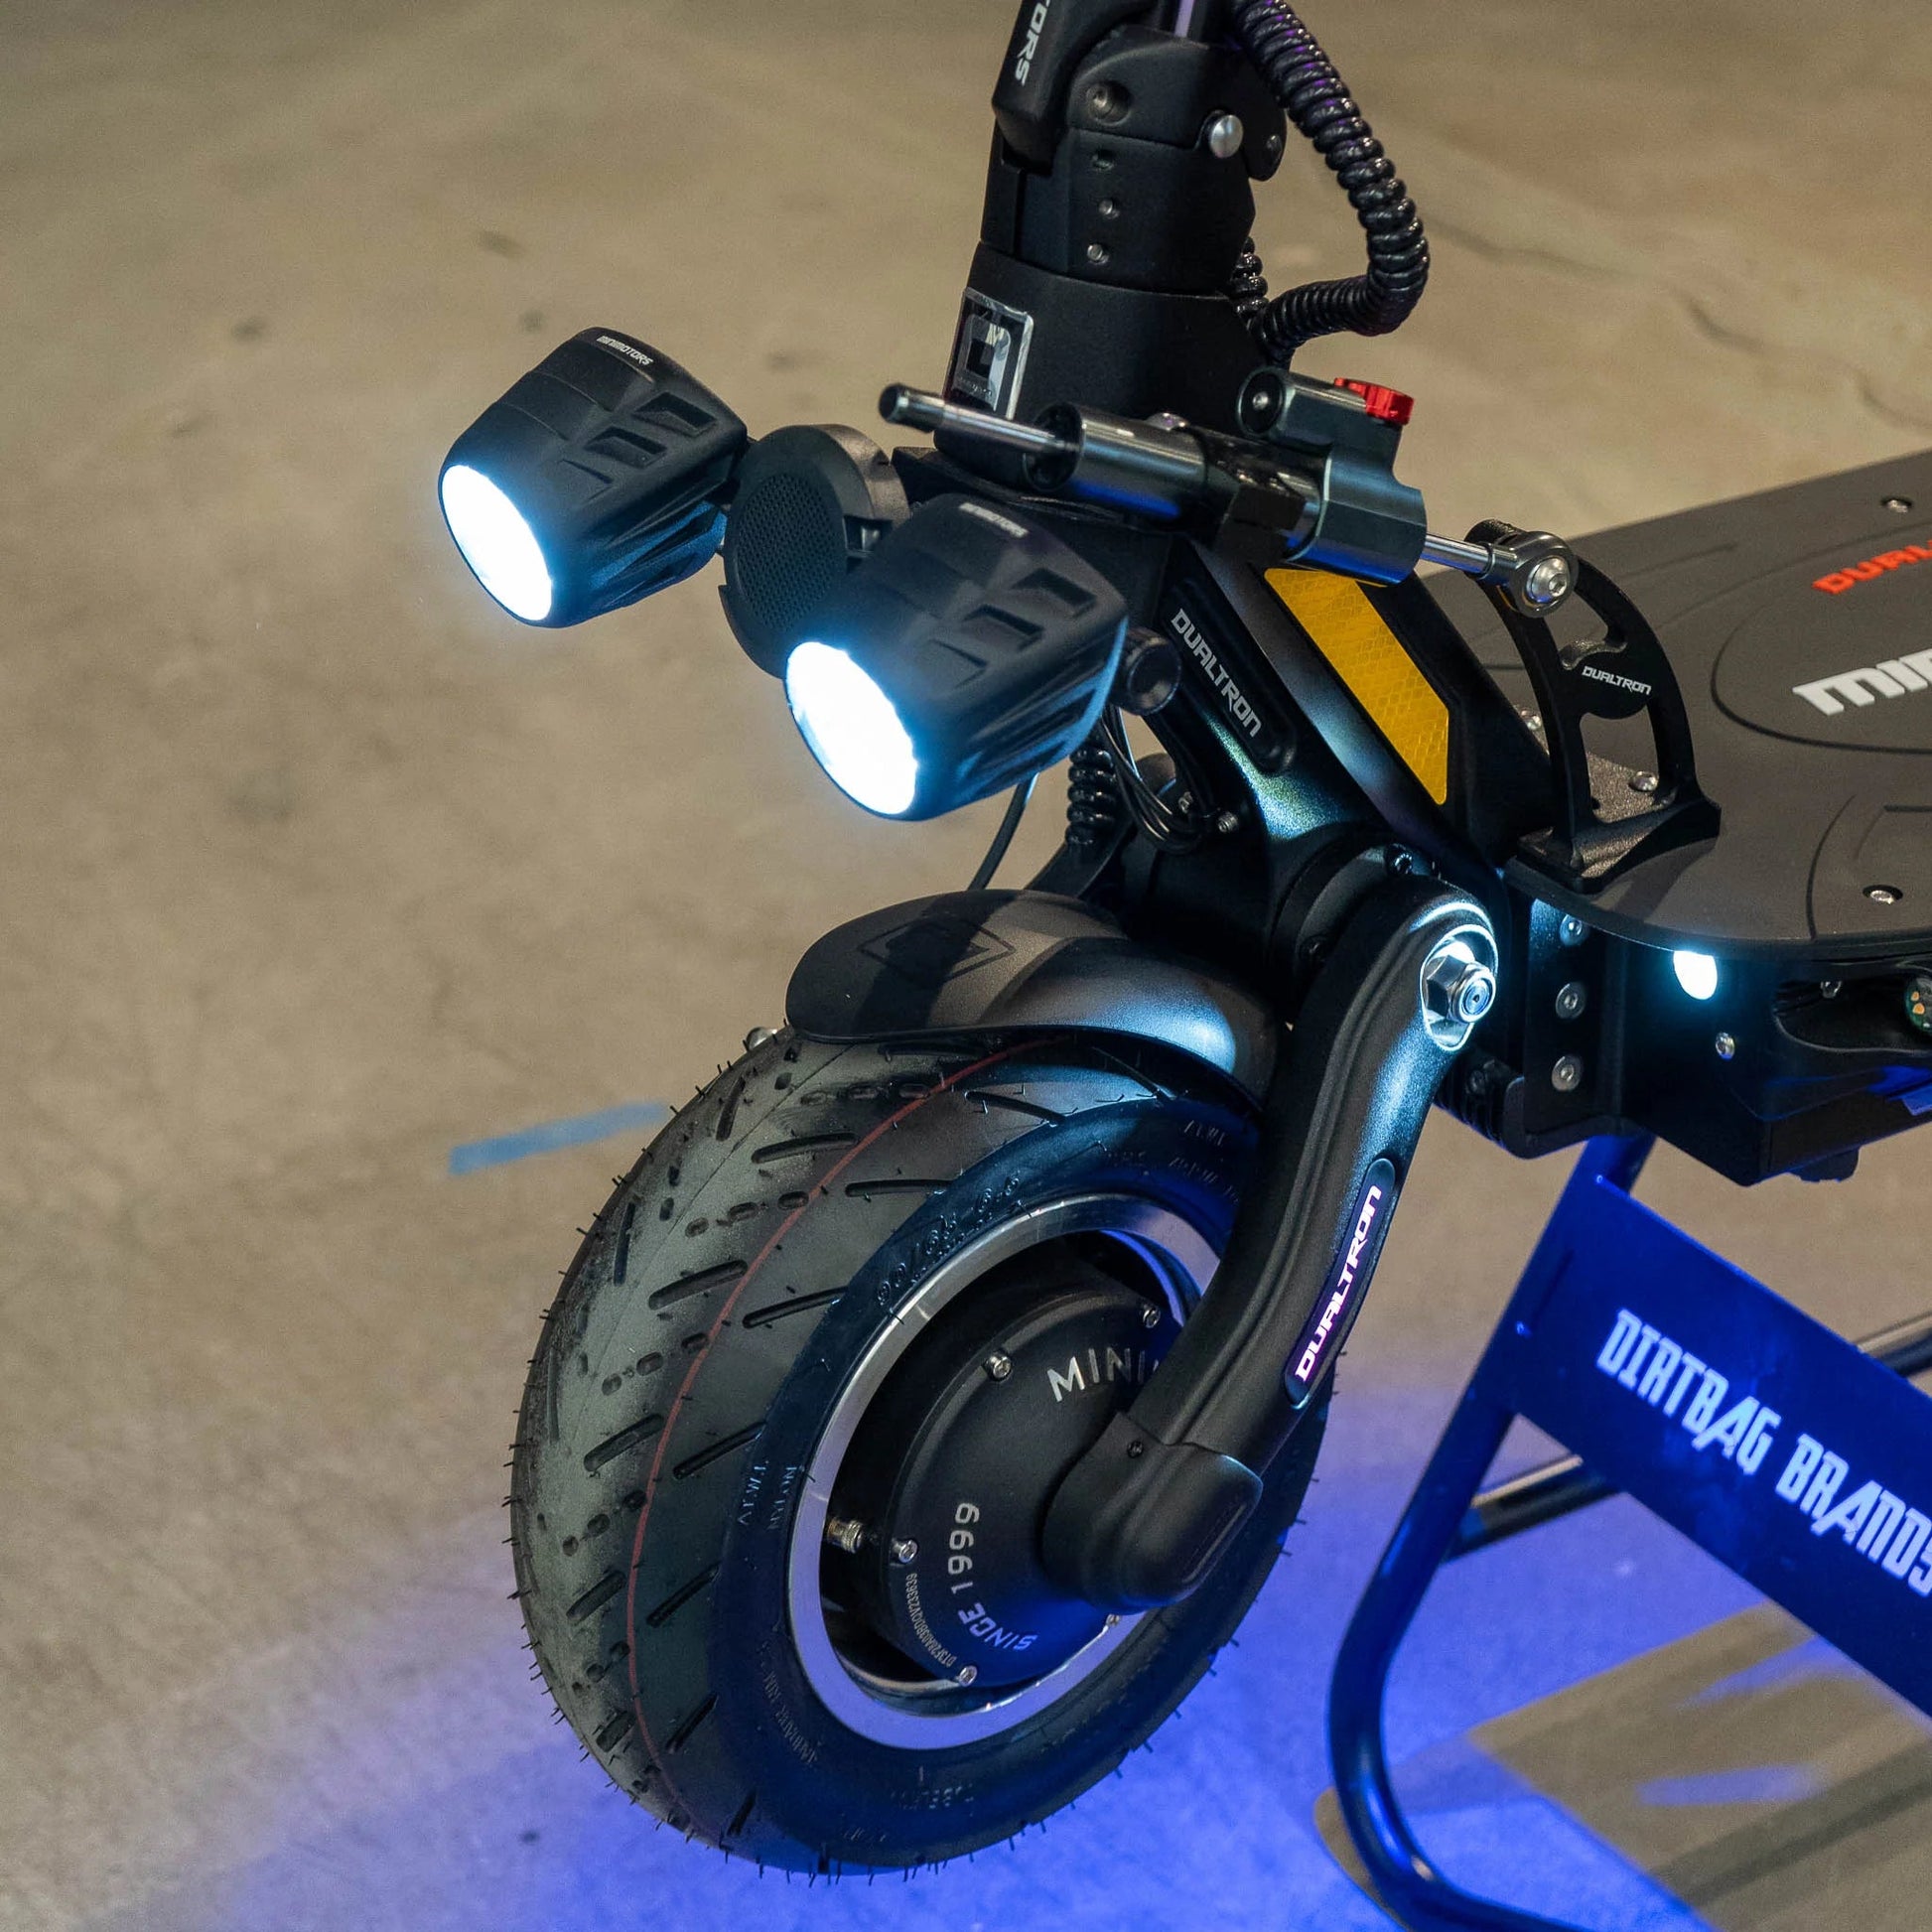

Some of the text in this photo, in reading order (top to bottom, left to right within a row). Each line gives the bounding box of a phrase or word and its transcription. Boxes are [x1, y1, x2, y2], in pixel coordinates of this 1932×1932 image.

[1016, 0, 1050, 86] ORS
[1811, 540, 1932, 595] DUAL
[1171, 608, 1262, 738] DUALTRON
[1582, 665, 1652, 695] DUALTRON
[1295, 1185, 1382, 1382] DUALTRON
[1046, 1347, 1160, 1403] MINI
[1596, 1308, 1932, 1596] DIRTBAG BRANDS
[948, 1502, 1038, 1650] SINCE 1999
